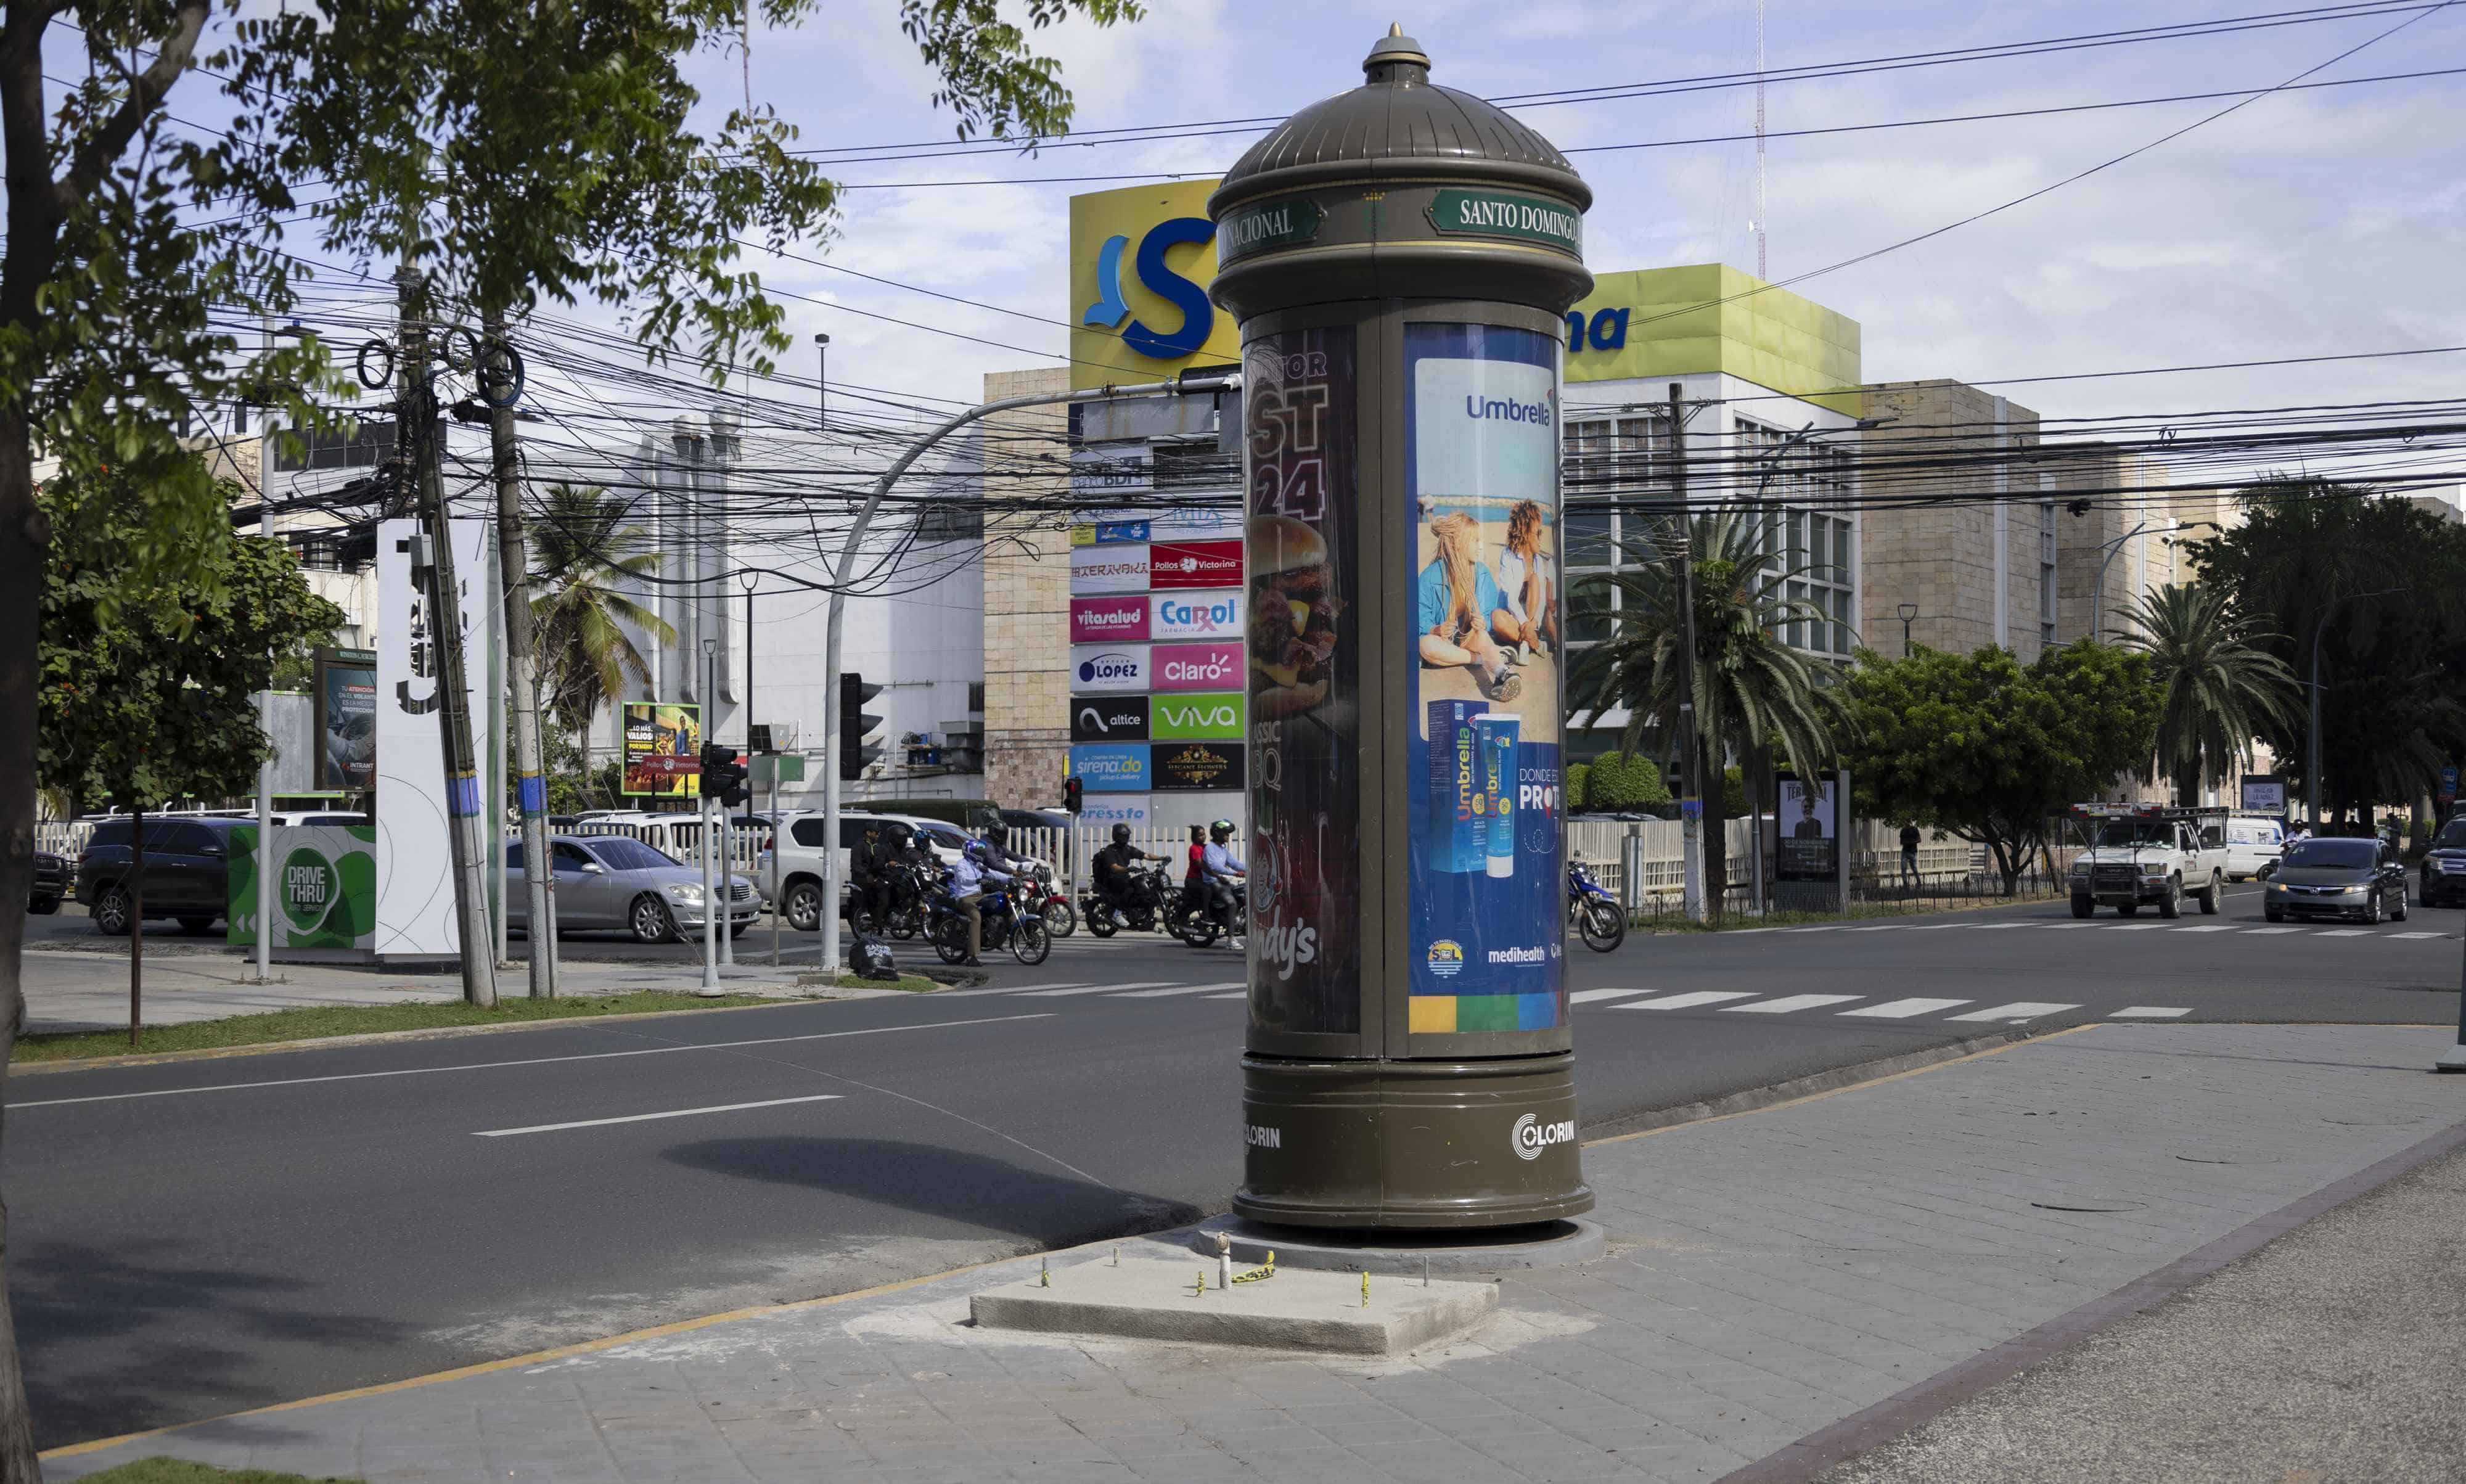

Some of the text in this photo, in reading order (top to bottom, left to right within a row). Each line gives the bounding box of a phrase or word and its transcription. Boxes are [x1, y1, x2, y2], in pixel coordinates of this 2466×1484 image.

[1460, 199, 1517, 228] SANTO
[1227, 208, 1293, 248] NACIONAL
[1467, 395, 1550, 427] Umbrella
[1155, 559, 1236, 569] Pollos Victorino
[1077, 609, 1141, 625] vitasalud
[1096, 665, 1137, 678] LOPEZ
[1165, 658, 1224, 681] Claro
[1110, 714, 1141, 725] altice
[627, 731, 653, 740] VALIOS
[1077, 755, 1142, 774] sirena.do
[1457, 727, 1472, 821] Umbrella
[1520, 768, 1551, 782] DONDE
[288, 866, 326, 884] DRIVE
[288, 884, 326, 903] THRU
[1488, 946, 1544, 963] medihealth
